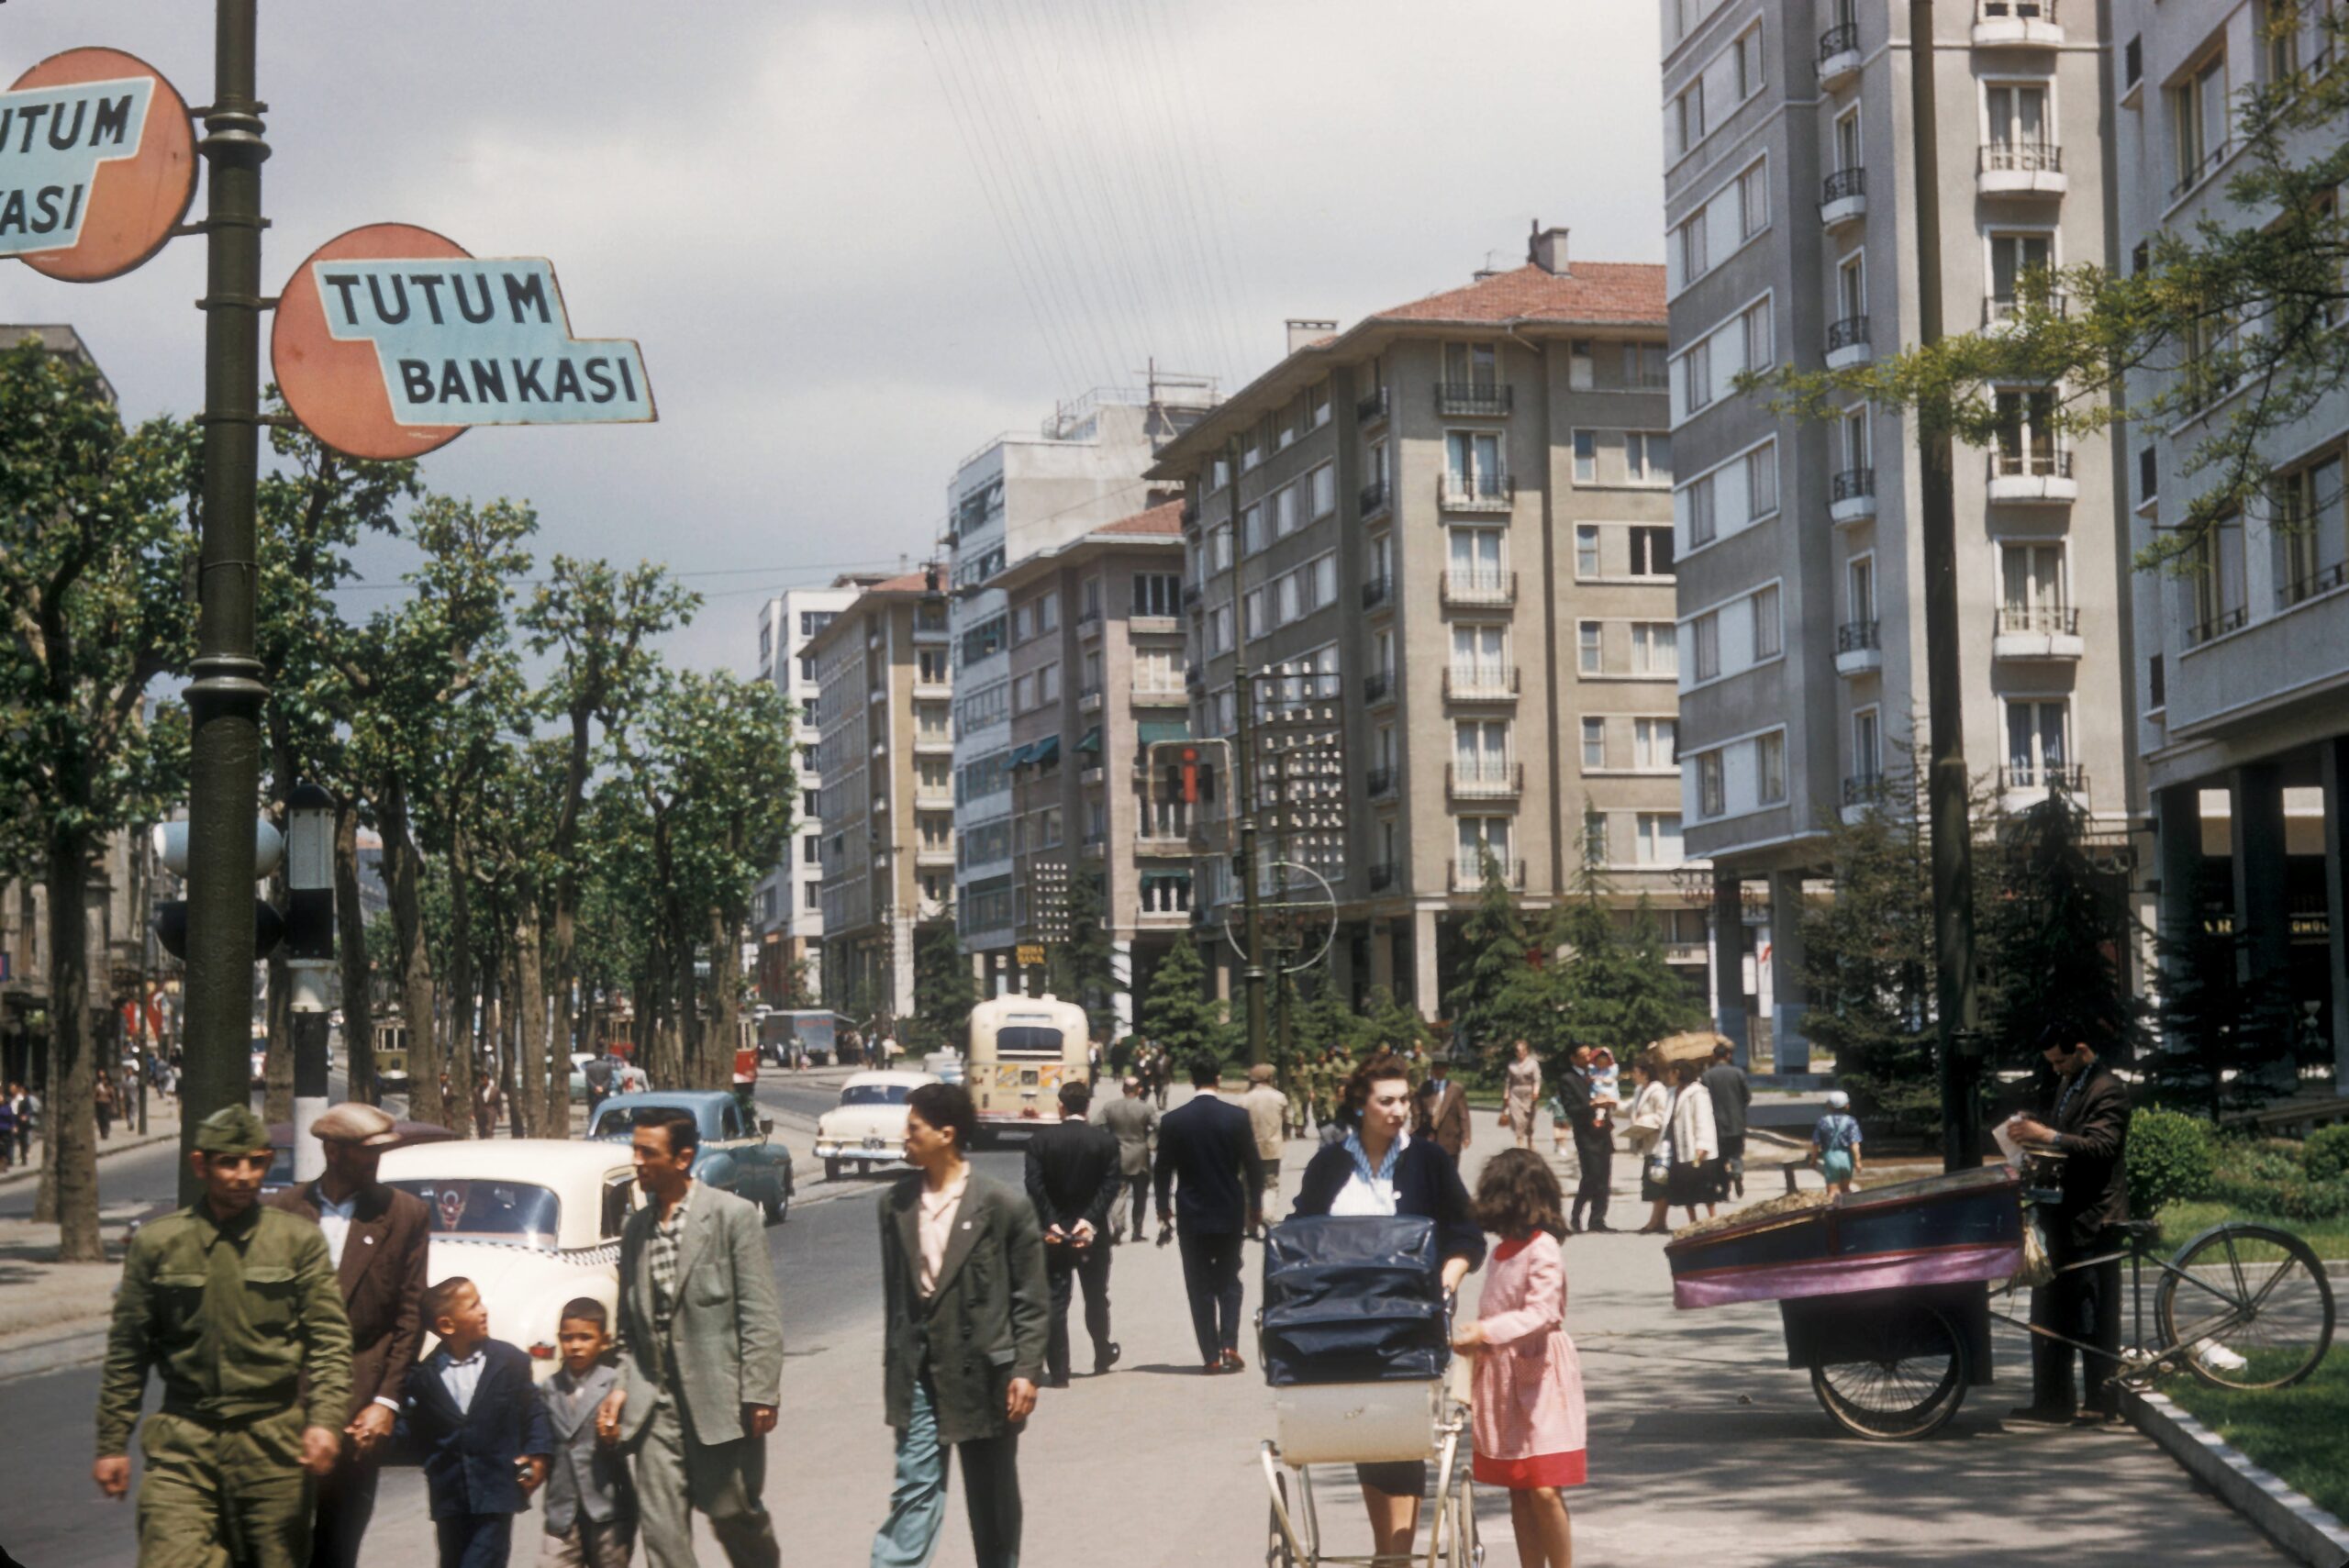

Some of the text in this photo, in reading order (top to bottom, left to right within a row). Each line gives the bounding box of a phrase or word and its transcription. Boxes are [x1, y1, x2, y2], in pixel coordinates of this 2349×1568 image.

[0, 183, 83, 235] ASI
[326, 272, 551, 325] TUTUM
[398, 357, 637, 405] BANKASI
